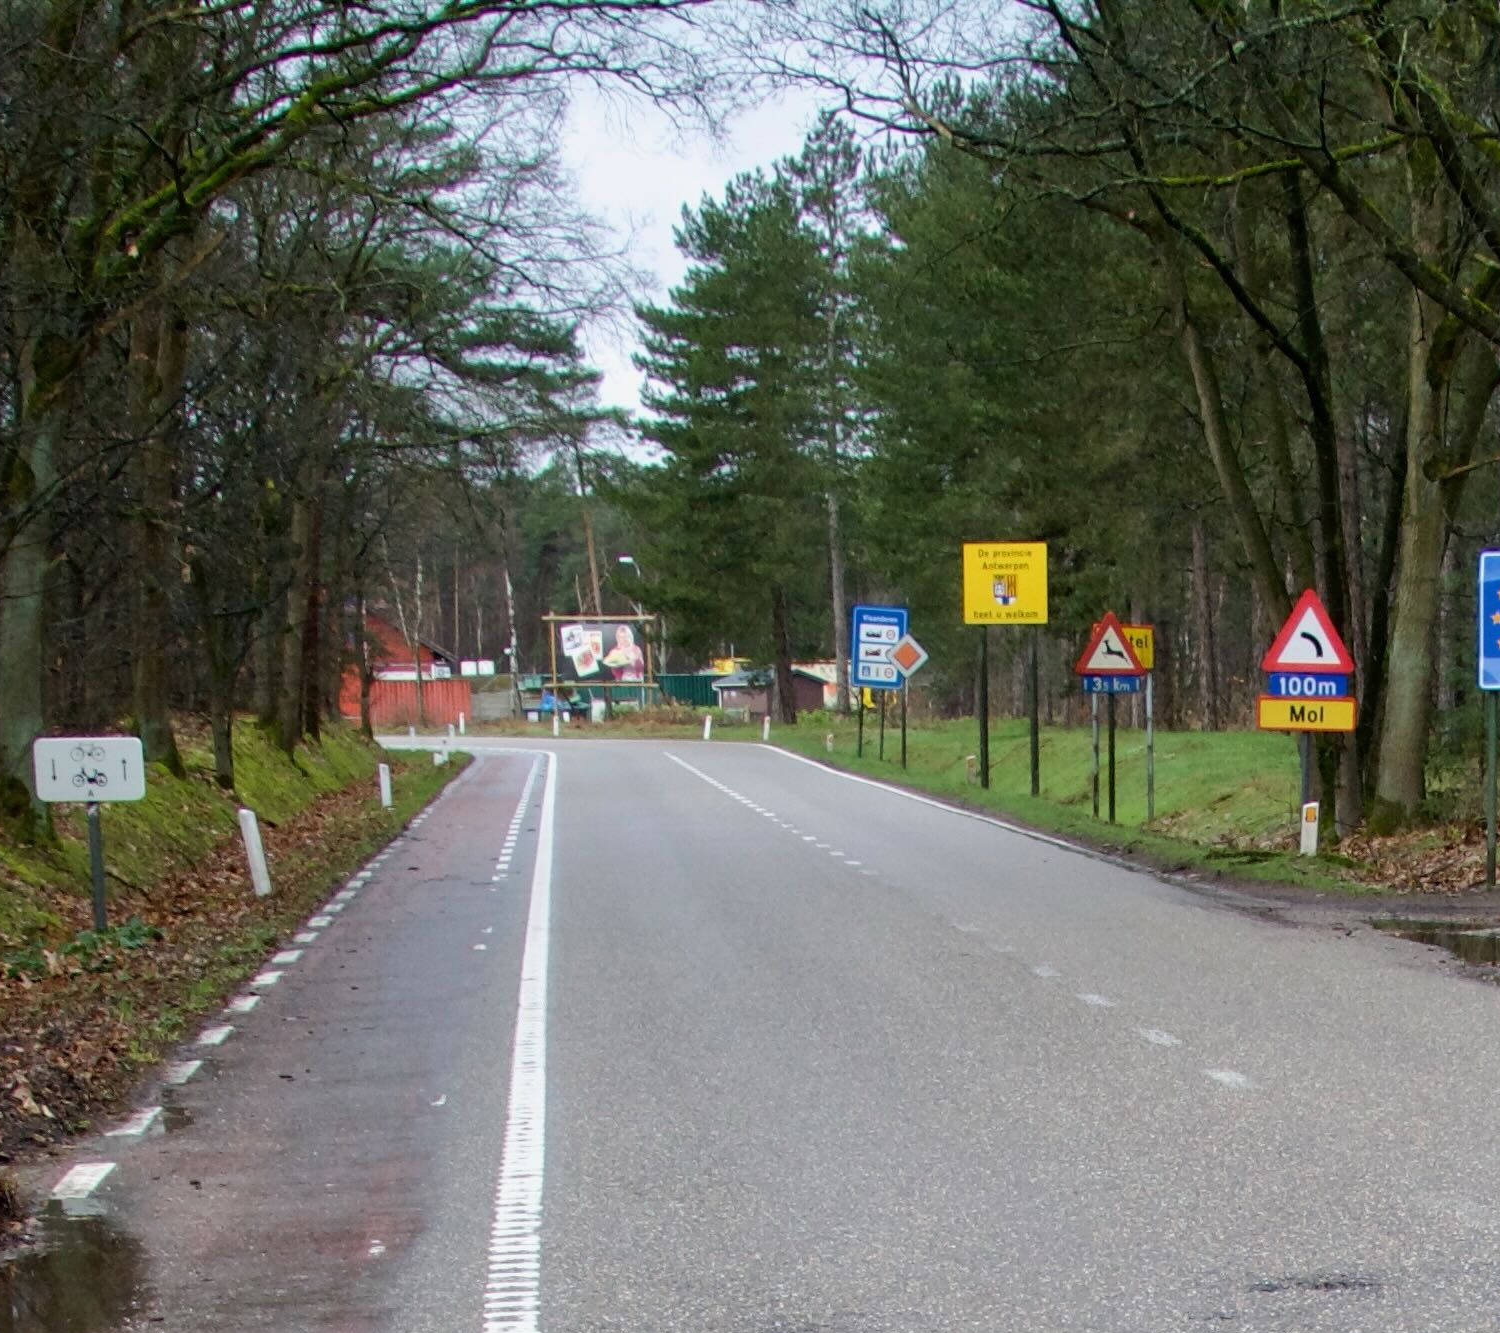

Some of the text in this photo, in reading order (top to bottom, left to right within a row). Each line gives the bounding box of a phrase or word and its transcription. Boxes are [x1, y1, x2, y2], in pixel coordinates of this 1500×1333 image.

[992, 549, 1033, 559] provincie
[982, 562, 1029, 571] Antwerpen
[1005, 610, 1039, 619] welkom
[1113, 677, 1131, 692] km
[1279, 676, 1337, 696] 100m
[1289, 705, 1325, 723] Mol
